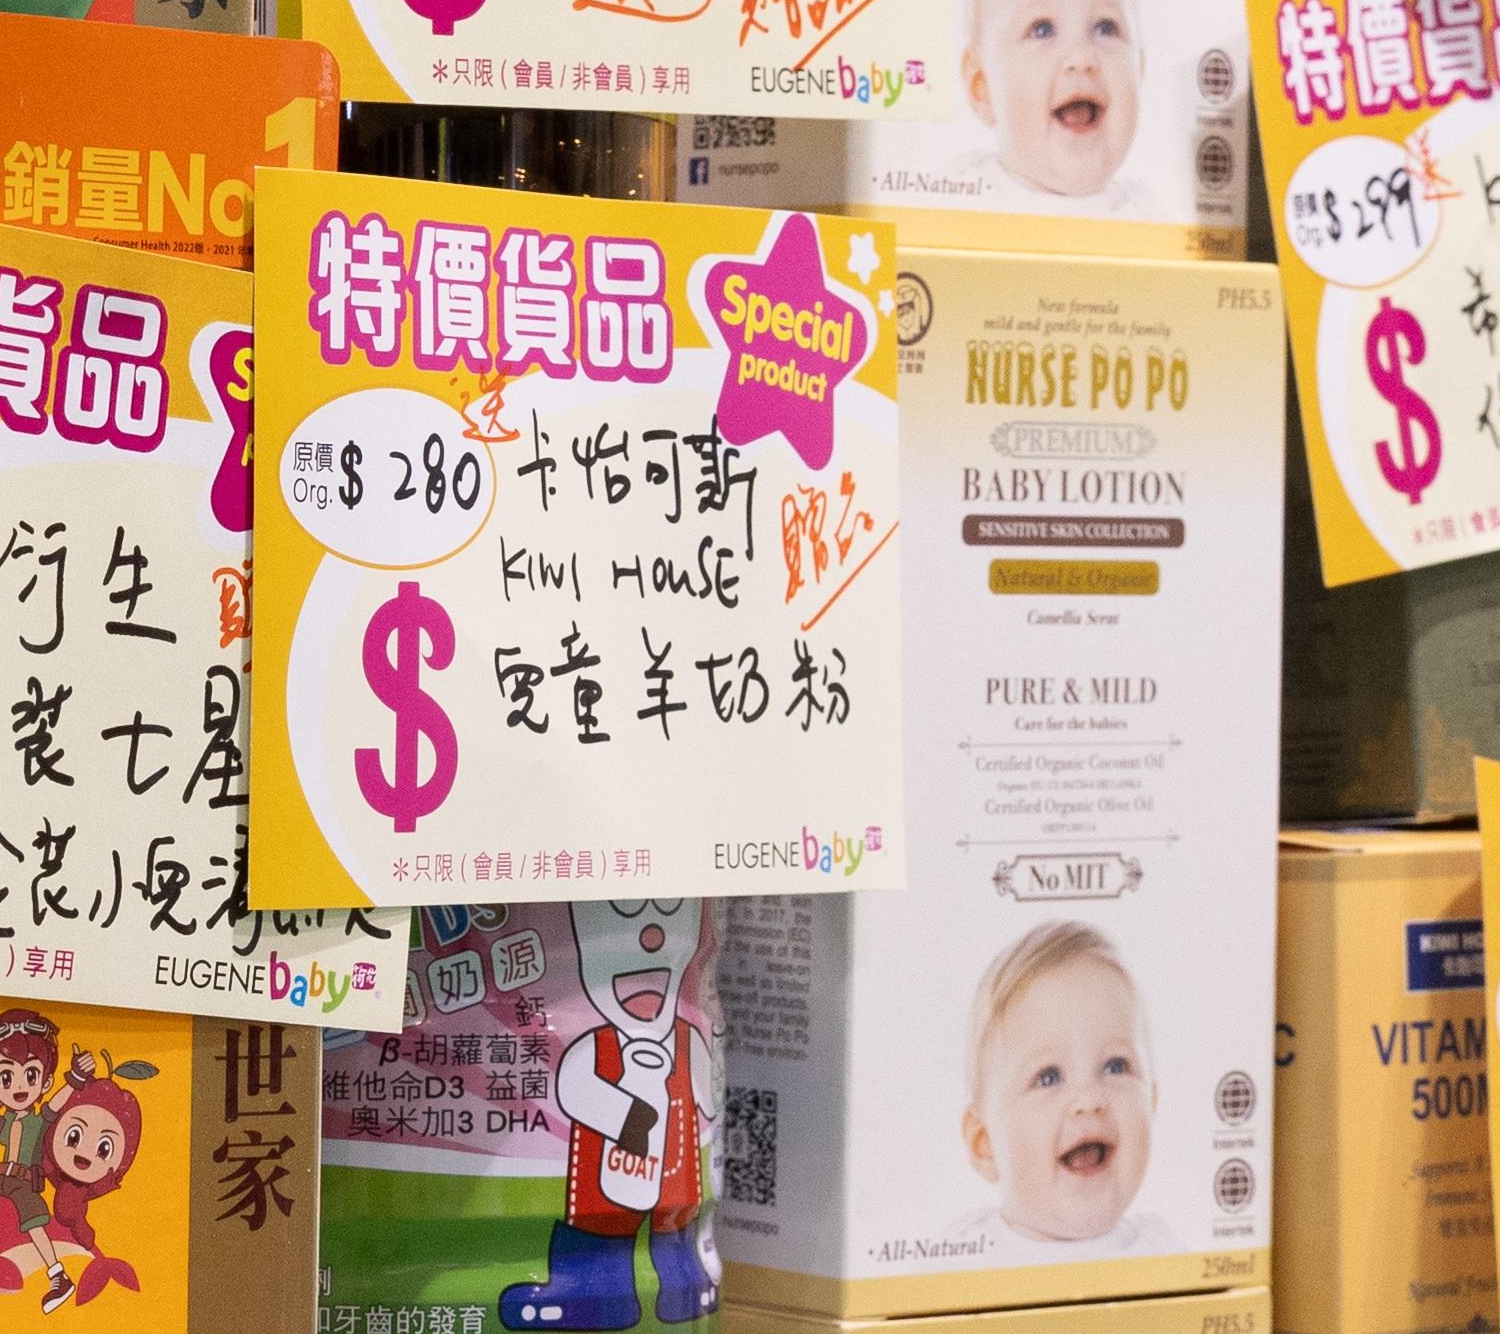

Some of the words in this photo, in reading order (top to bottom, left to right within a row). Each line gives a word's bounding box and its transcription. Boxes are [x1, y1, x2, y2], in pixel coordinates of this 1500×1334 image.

[1217, 288, 1272, 310] PH5.5
[738, 353, 828, 402] product
[966, 340, 1078, 408] NURSE
[1090, 344, 1134, 411] PO
[1146, 346, 1190, 411] PO
[292, 442, 335, 474] 原價
[1014, 428, 1135, 454] PREMIUM
[293, 478, 334, 507] Org.
[390, 434, 482, 514] 280
[962, 467, 1052, 503] BABY
[1060, 470, 1188, 505] LOTION
[1028, 866, 1059, 891] No
[1065, 862, 1108, 890] MIT
[607, 1146, 659, 1183] GOAT
